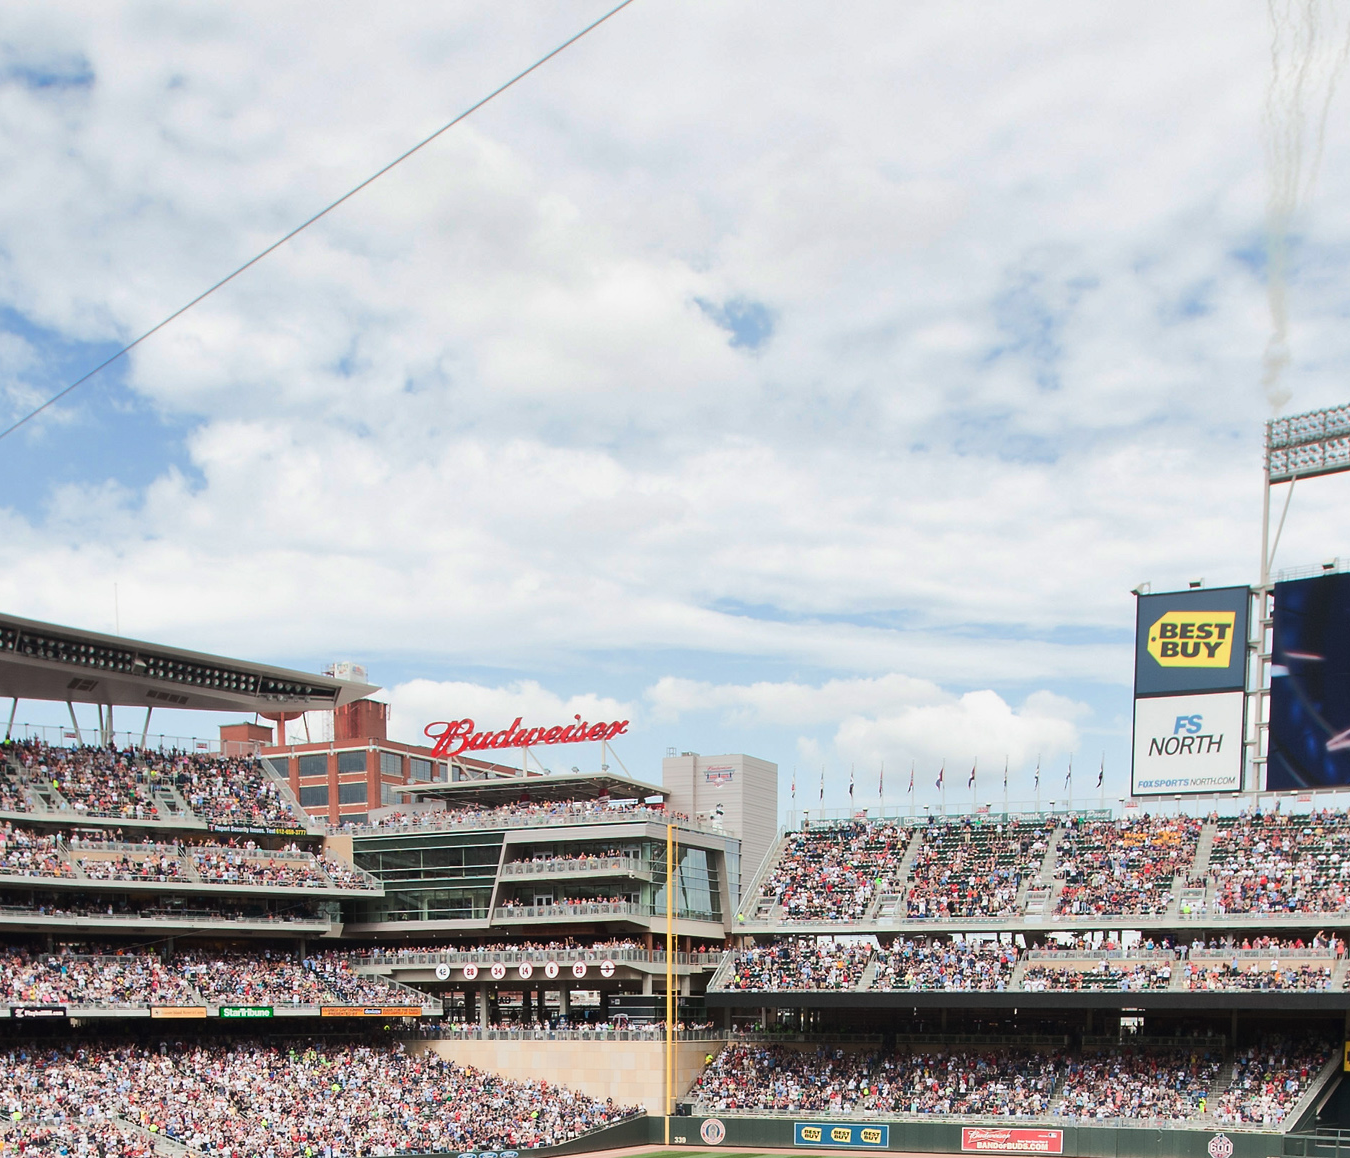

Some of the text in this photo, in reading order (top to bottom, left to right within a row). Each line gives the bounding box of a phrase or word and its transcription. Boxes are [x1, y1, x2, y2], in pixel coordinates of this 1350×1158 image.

[1159, 623, 1232, 640] BEST
[1160, 641, 1224, 659] BUY
[1174, 714, 1203, 735] FS
[424, 713, 630, 759] Budweiser
[1149, 734, 1224, 757] NORTH
[223, 1008, 270, 1017] StarTribune
[1210, 1143, 1231, 1153] 600
